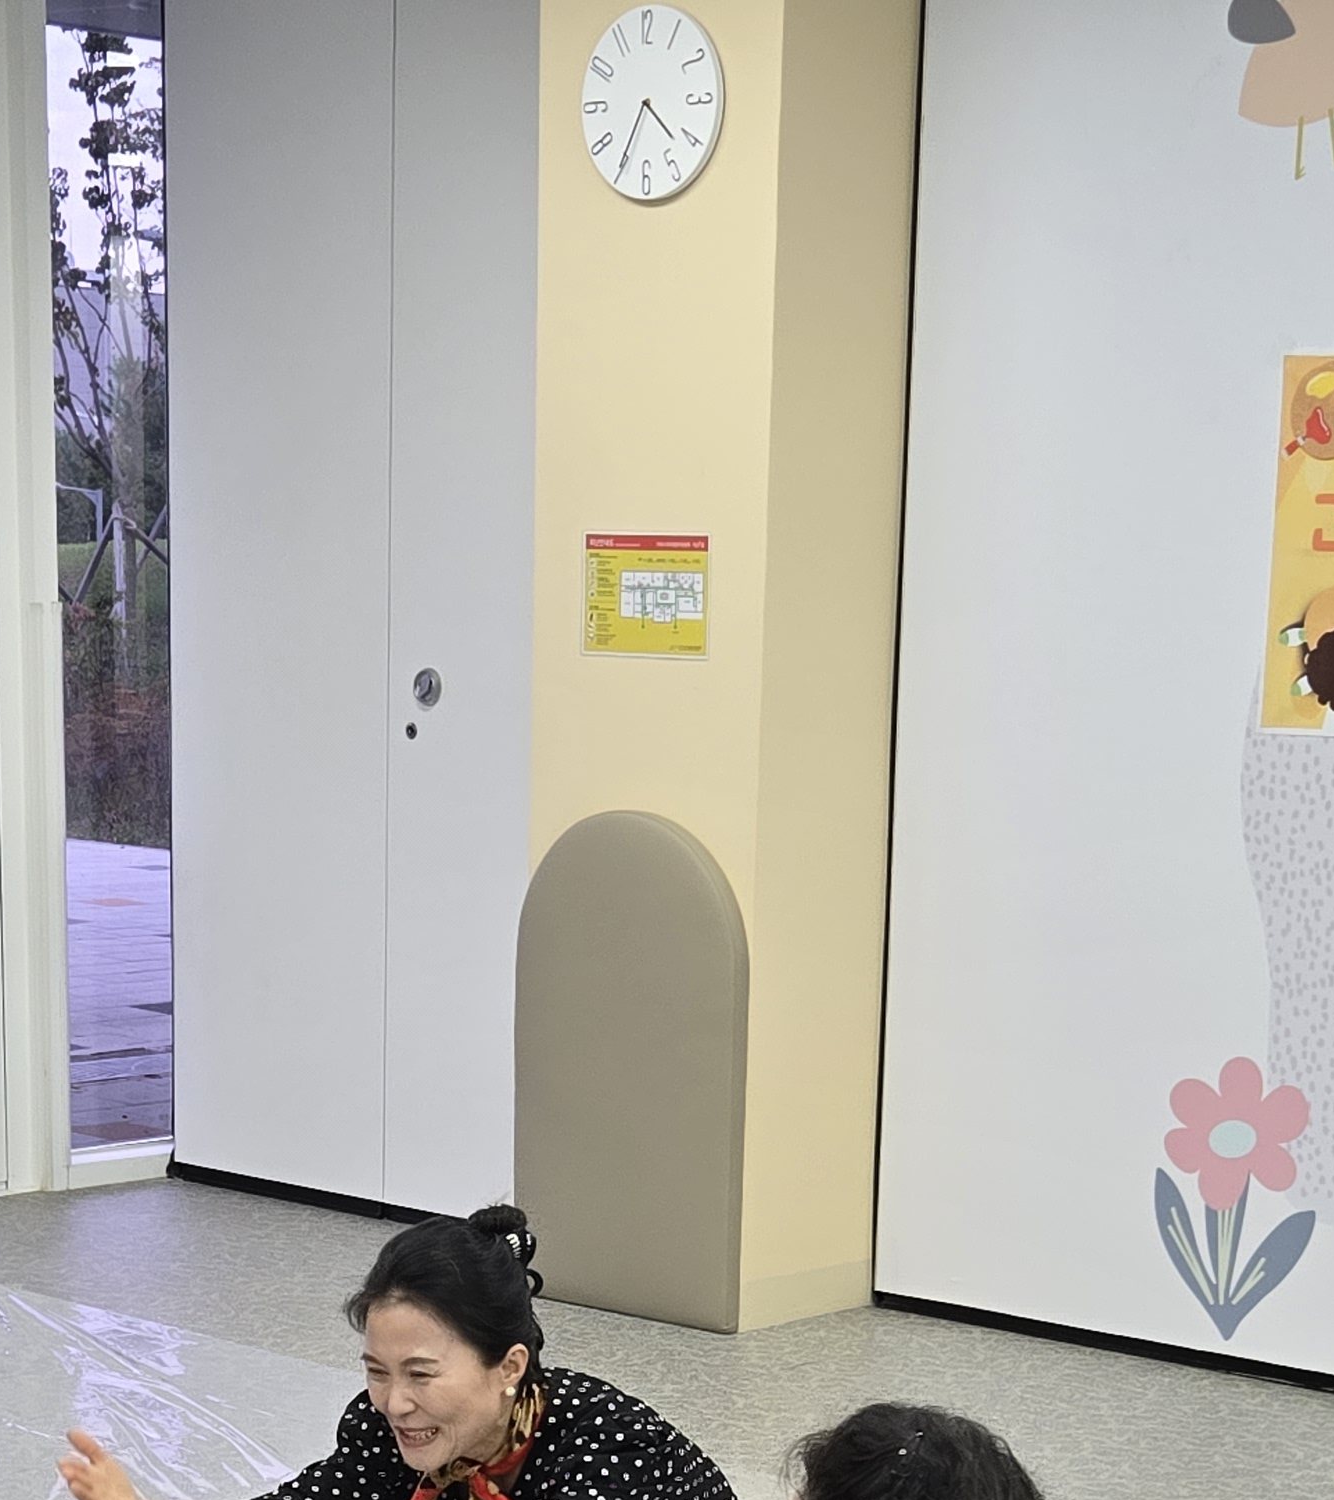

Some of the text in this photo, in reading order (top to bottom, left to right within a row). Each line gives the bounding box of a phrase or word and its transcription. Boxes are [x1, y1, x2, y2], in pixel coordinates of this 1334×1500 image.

[642, 10, 652, 44] 12
[590, 56, 614, 82] 10
[682, 49, 704, 74] 2
[584, 101, 608, 113] 9
[686, 93, 712, 105] 3
[592, 133, 613, 155] 8
[682, 128, 703, 146] 4
[642, 160, 651, 195] 6
[664, 149, 681, 181] 5
